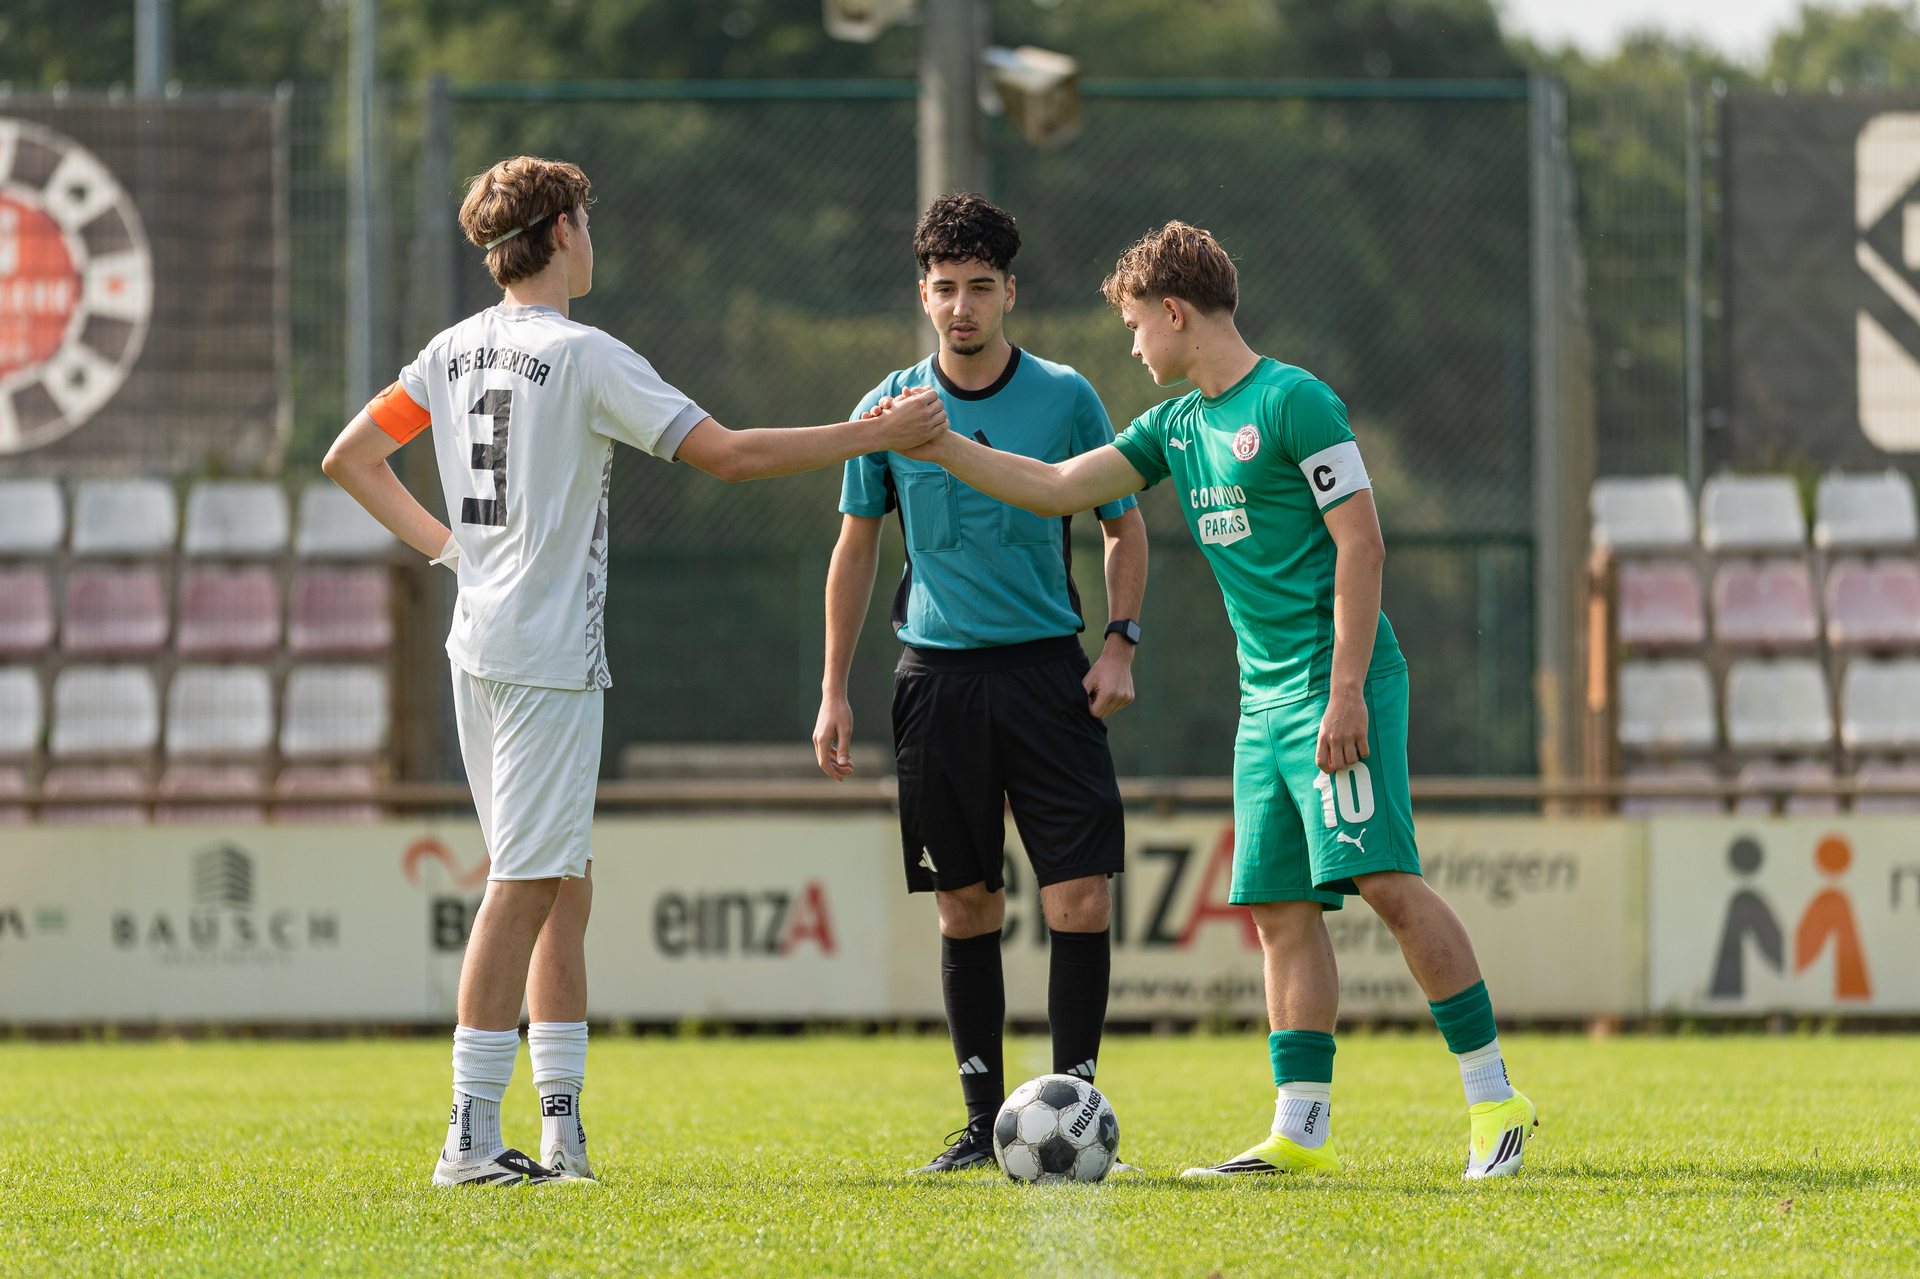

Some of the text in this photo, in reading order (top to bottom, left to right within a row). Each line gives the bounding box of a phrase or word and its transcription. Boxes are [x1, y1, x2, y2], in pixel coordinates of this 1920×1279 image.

[461, 389, 512, 527] 3
[1313, 465, 1336, 492] C
[1205, 515, 1246, 537] PARKS
[1313, 761, 1375, 828] 10
[542, 1095, 570, 1115] FS
